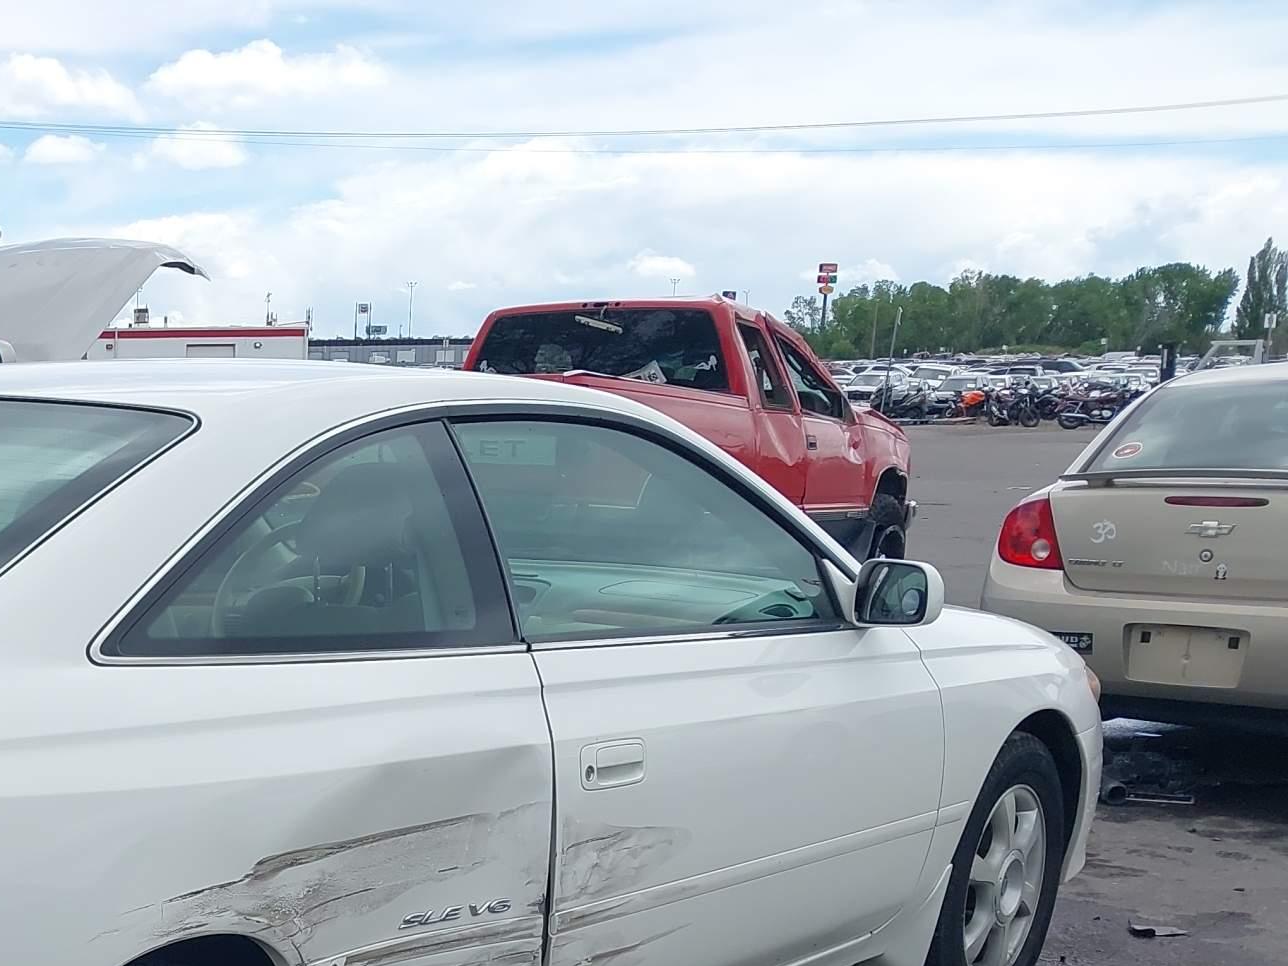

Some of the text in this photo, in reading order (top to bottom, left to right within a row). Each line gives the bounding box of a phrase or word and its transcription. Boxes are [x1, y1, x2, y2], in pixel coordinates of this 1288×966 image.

[467, 439, 527, 458] ET
[397, 898, 513, 930] SLE V6
